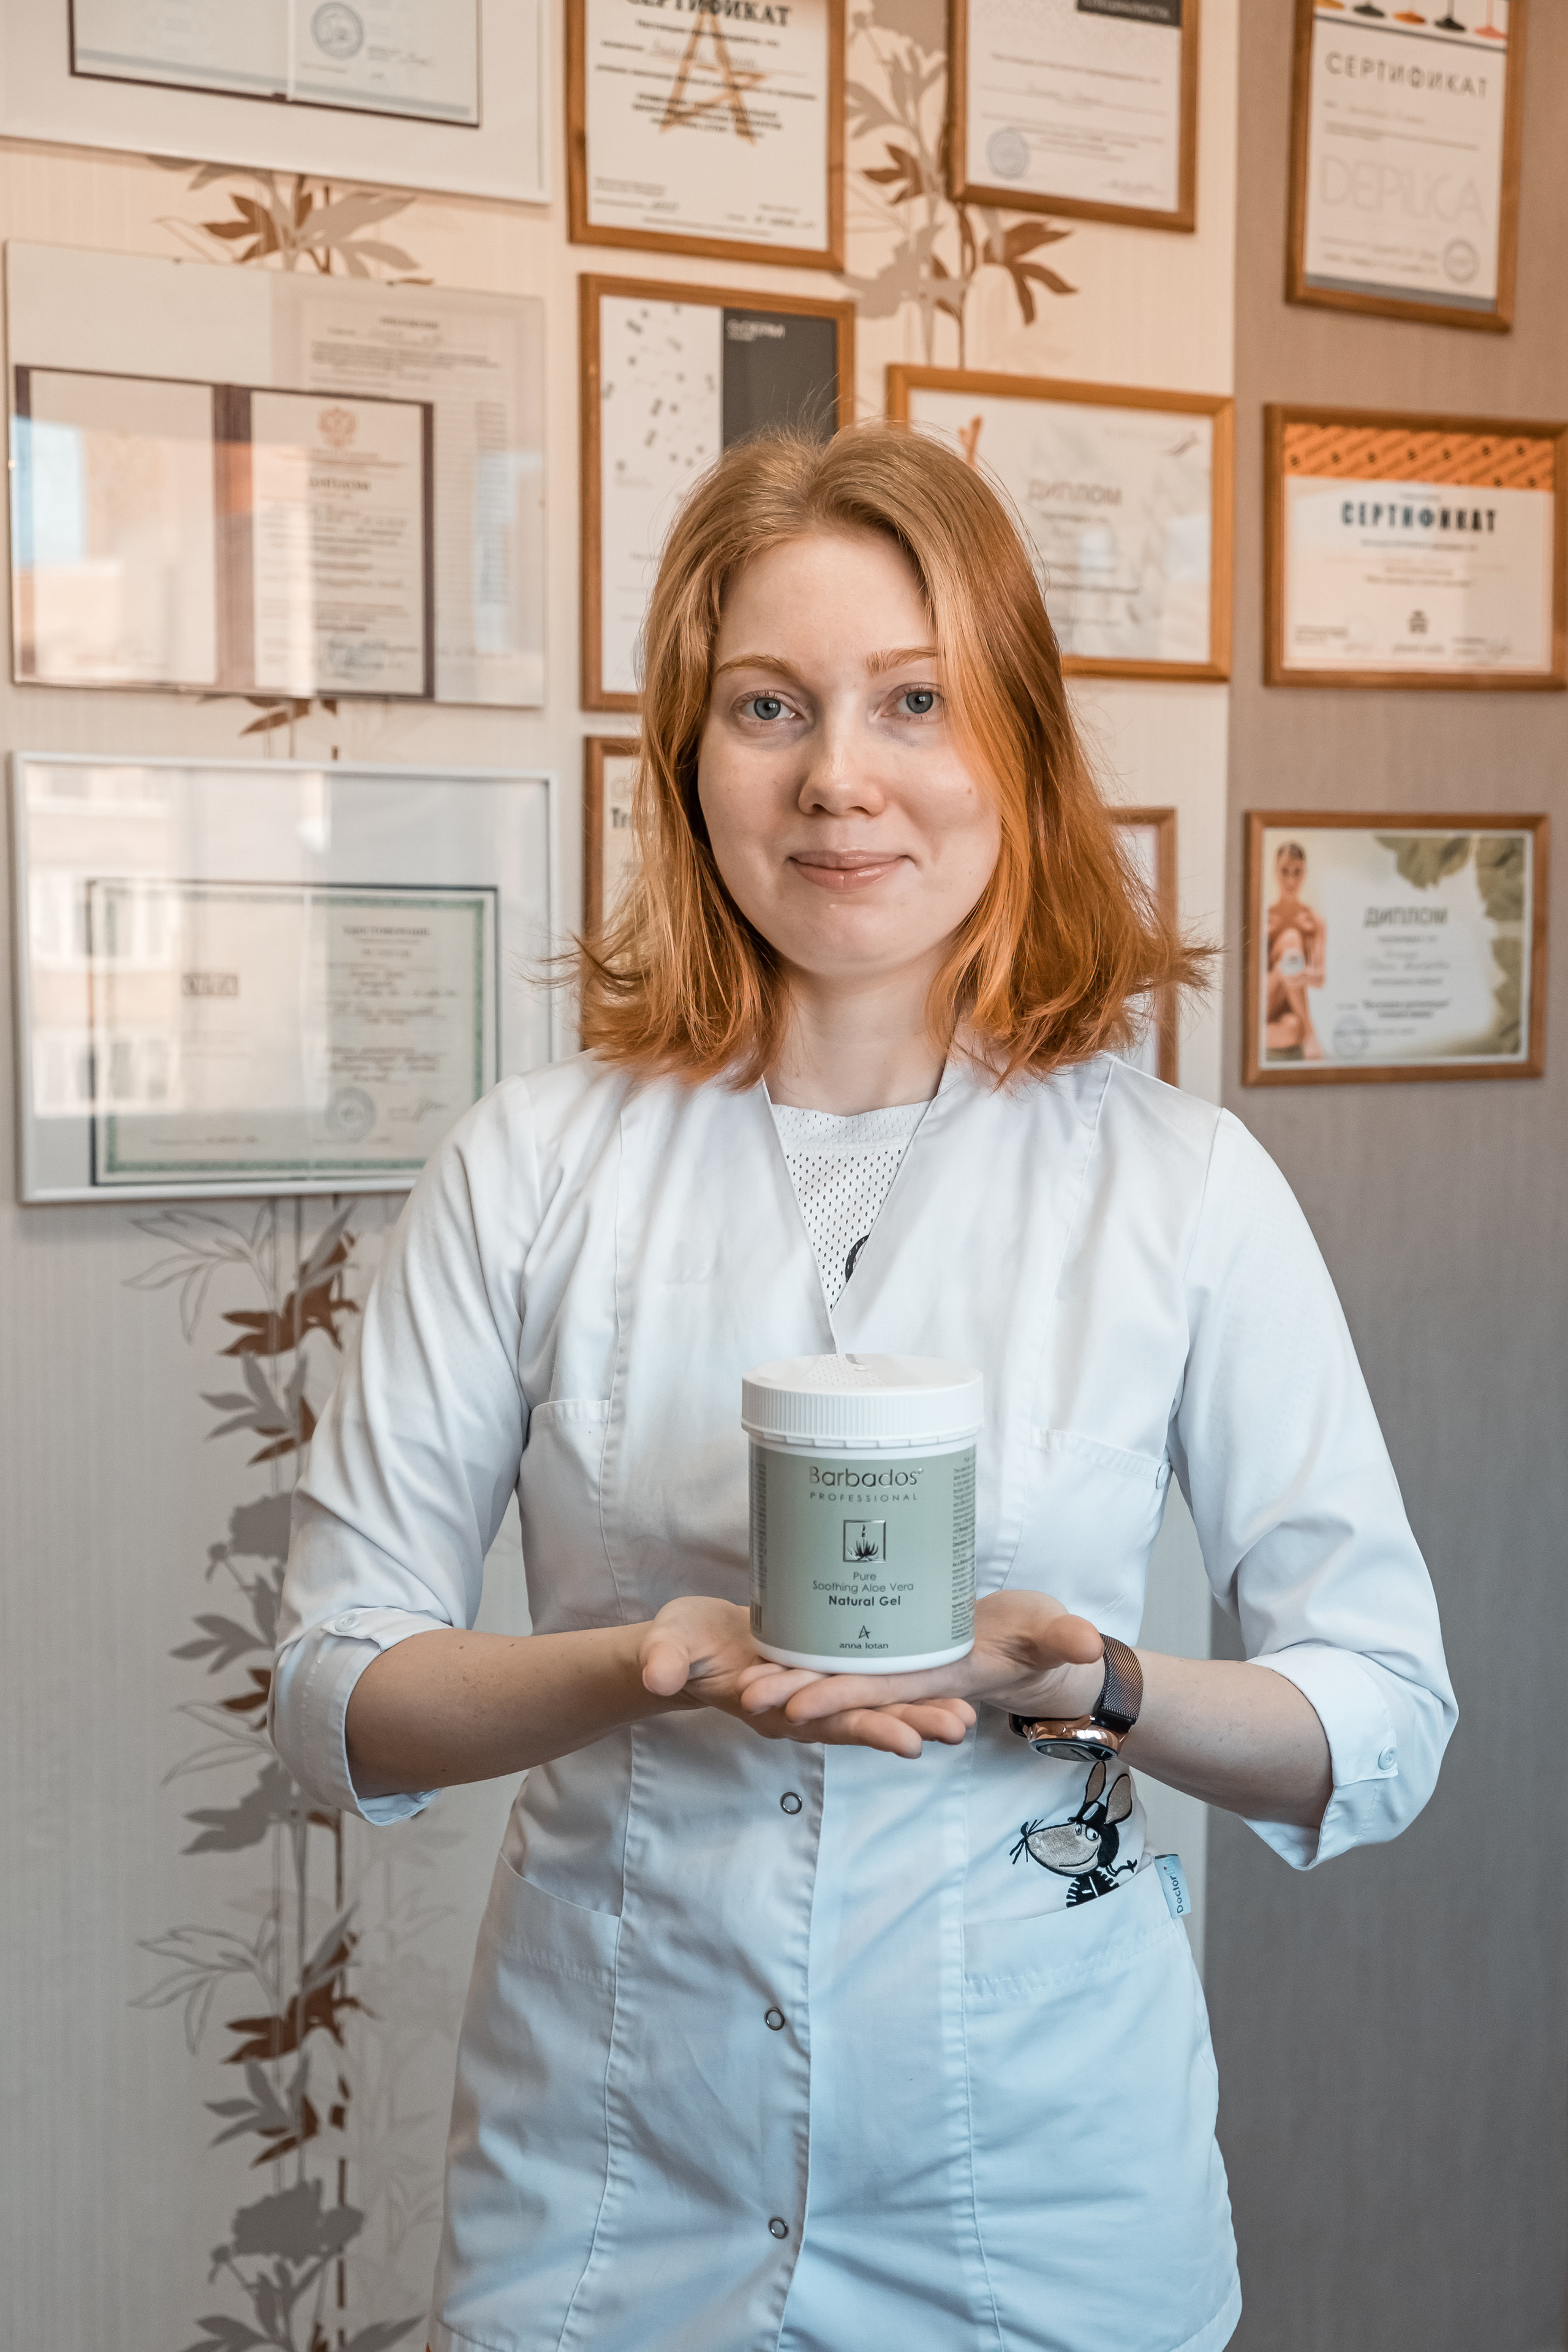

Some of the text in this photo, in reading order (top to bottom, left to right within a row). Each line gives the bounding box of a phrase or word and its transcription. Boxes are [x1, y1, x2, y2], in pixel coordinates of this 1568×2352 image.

[1325, 51, 1488, 99] СЕРТИФИКАТ
[1341, 501, 1495, 533] СЕРТИФИКАТ
[810, 1466, 918, 1488] Barbados
[810, 1492, 918, 1502] PROFESSIONAL
[853, 1572, 877, 1581] Pure
[812, 1580, 914, 1594] Soothing Aloe Vera
[829, 1595, 901, 1607] Natural Gel
